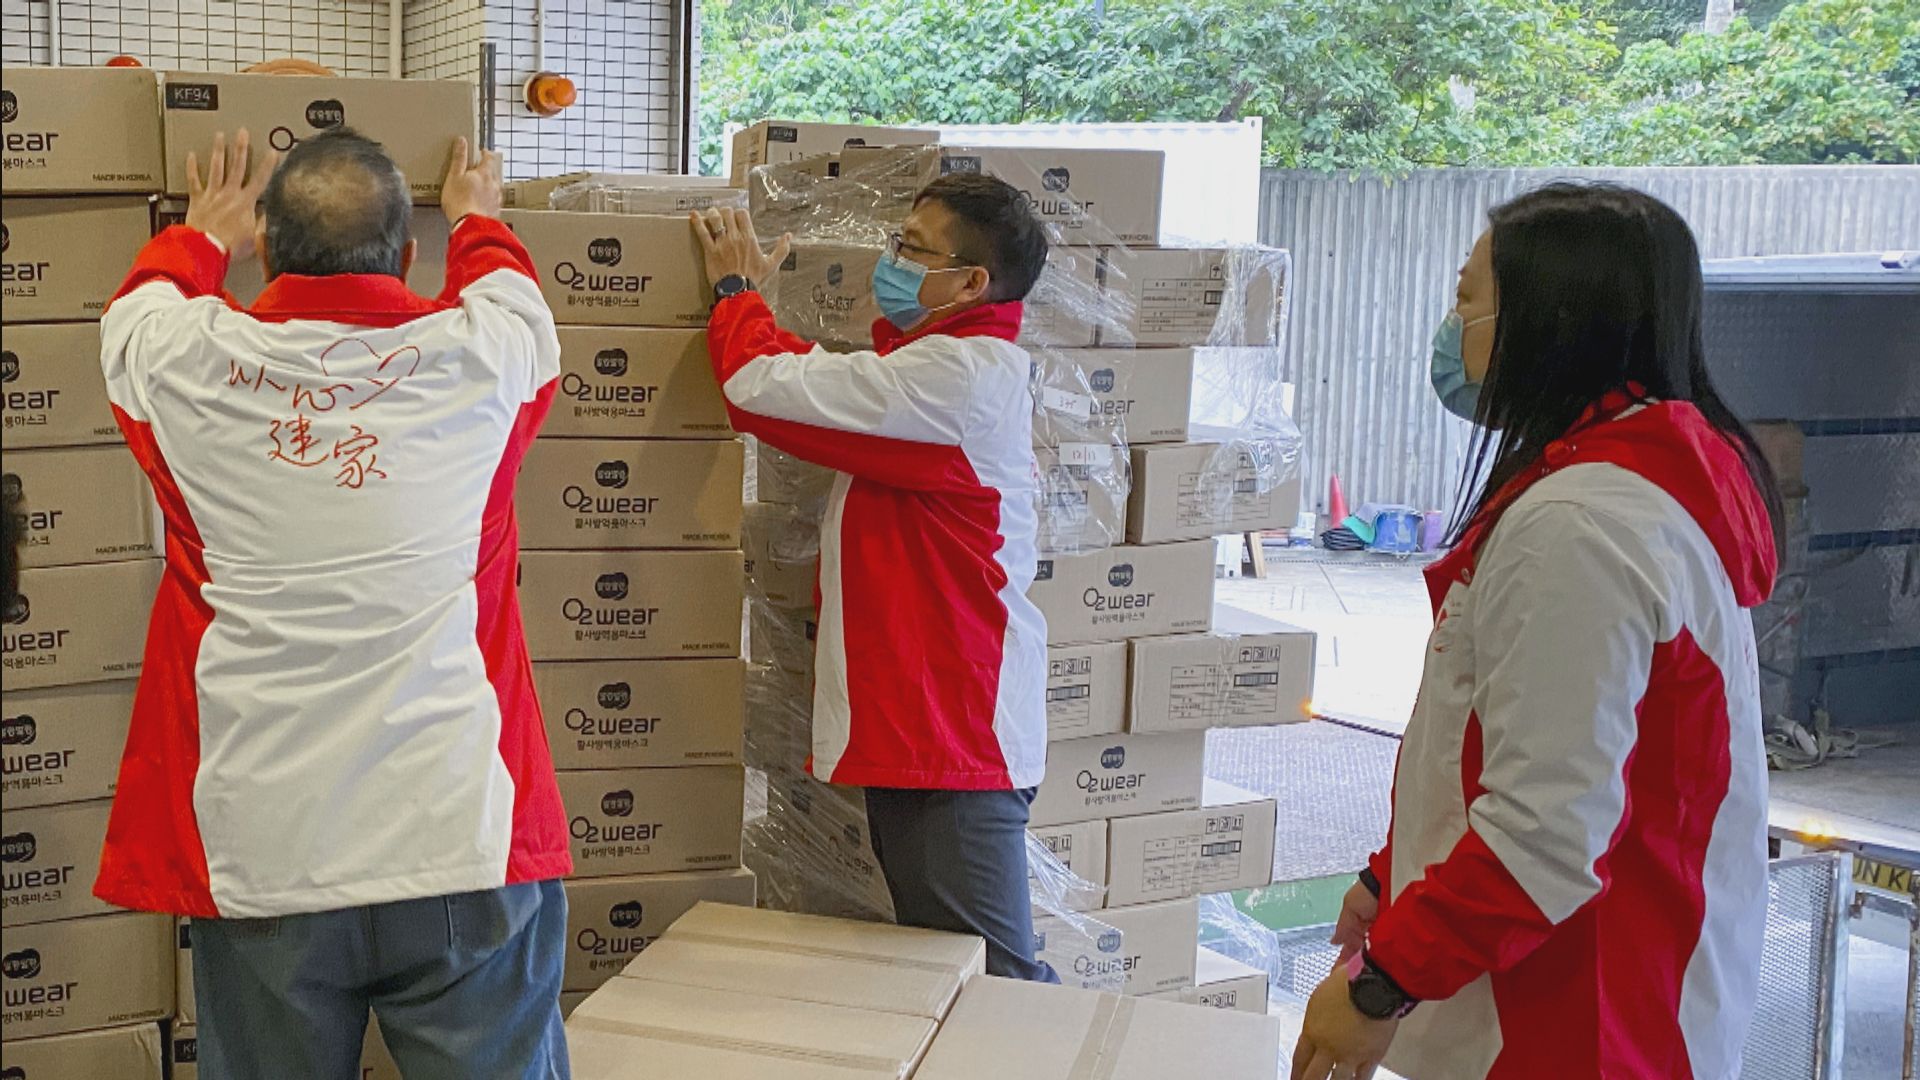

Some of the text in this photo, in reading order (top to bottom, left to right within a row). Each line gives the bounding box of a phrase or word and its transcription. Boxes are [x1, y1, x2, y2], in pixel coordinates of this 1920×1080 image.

[174, 88, 210, 101] KF94
[555, 261, 653, 292] O2wear
[562, 372, 659, 403] O2wear
[563, 485, 660, 514] O2wear
[563, 597, 659, 625] O2wear
[1083, 586, 1156, 611] O2wear
[565, 707, 662, 735] O2wear
[2, 750, 76, 775] wear
[1076, 769, 1147, 793] O2wear
[569, 816, 663, 843] O2wear
[2, 866, 75, 891] wear
[5, 981, 79, 1007] wear
